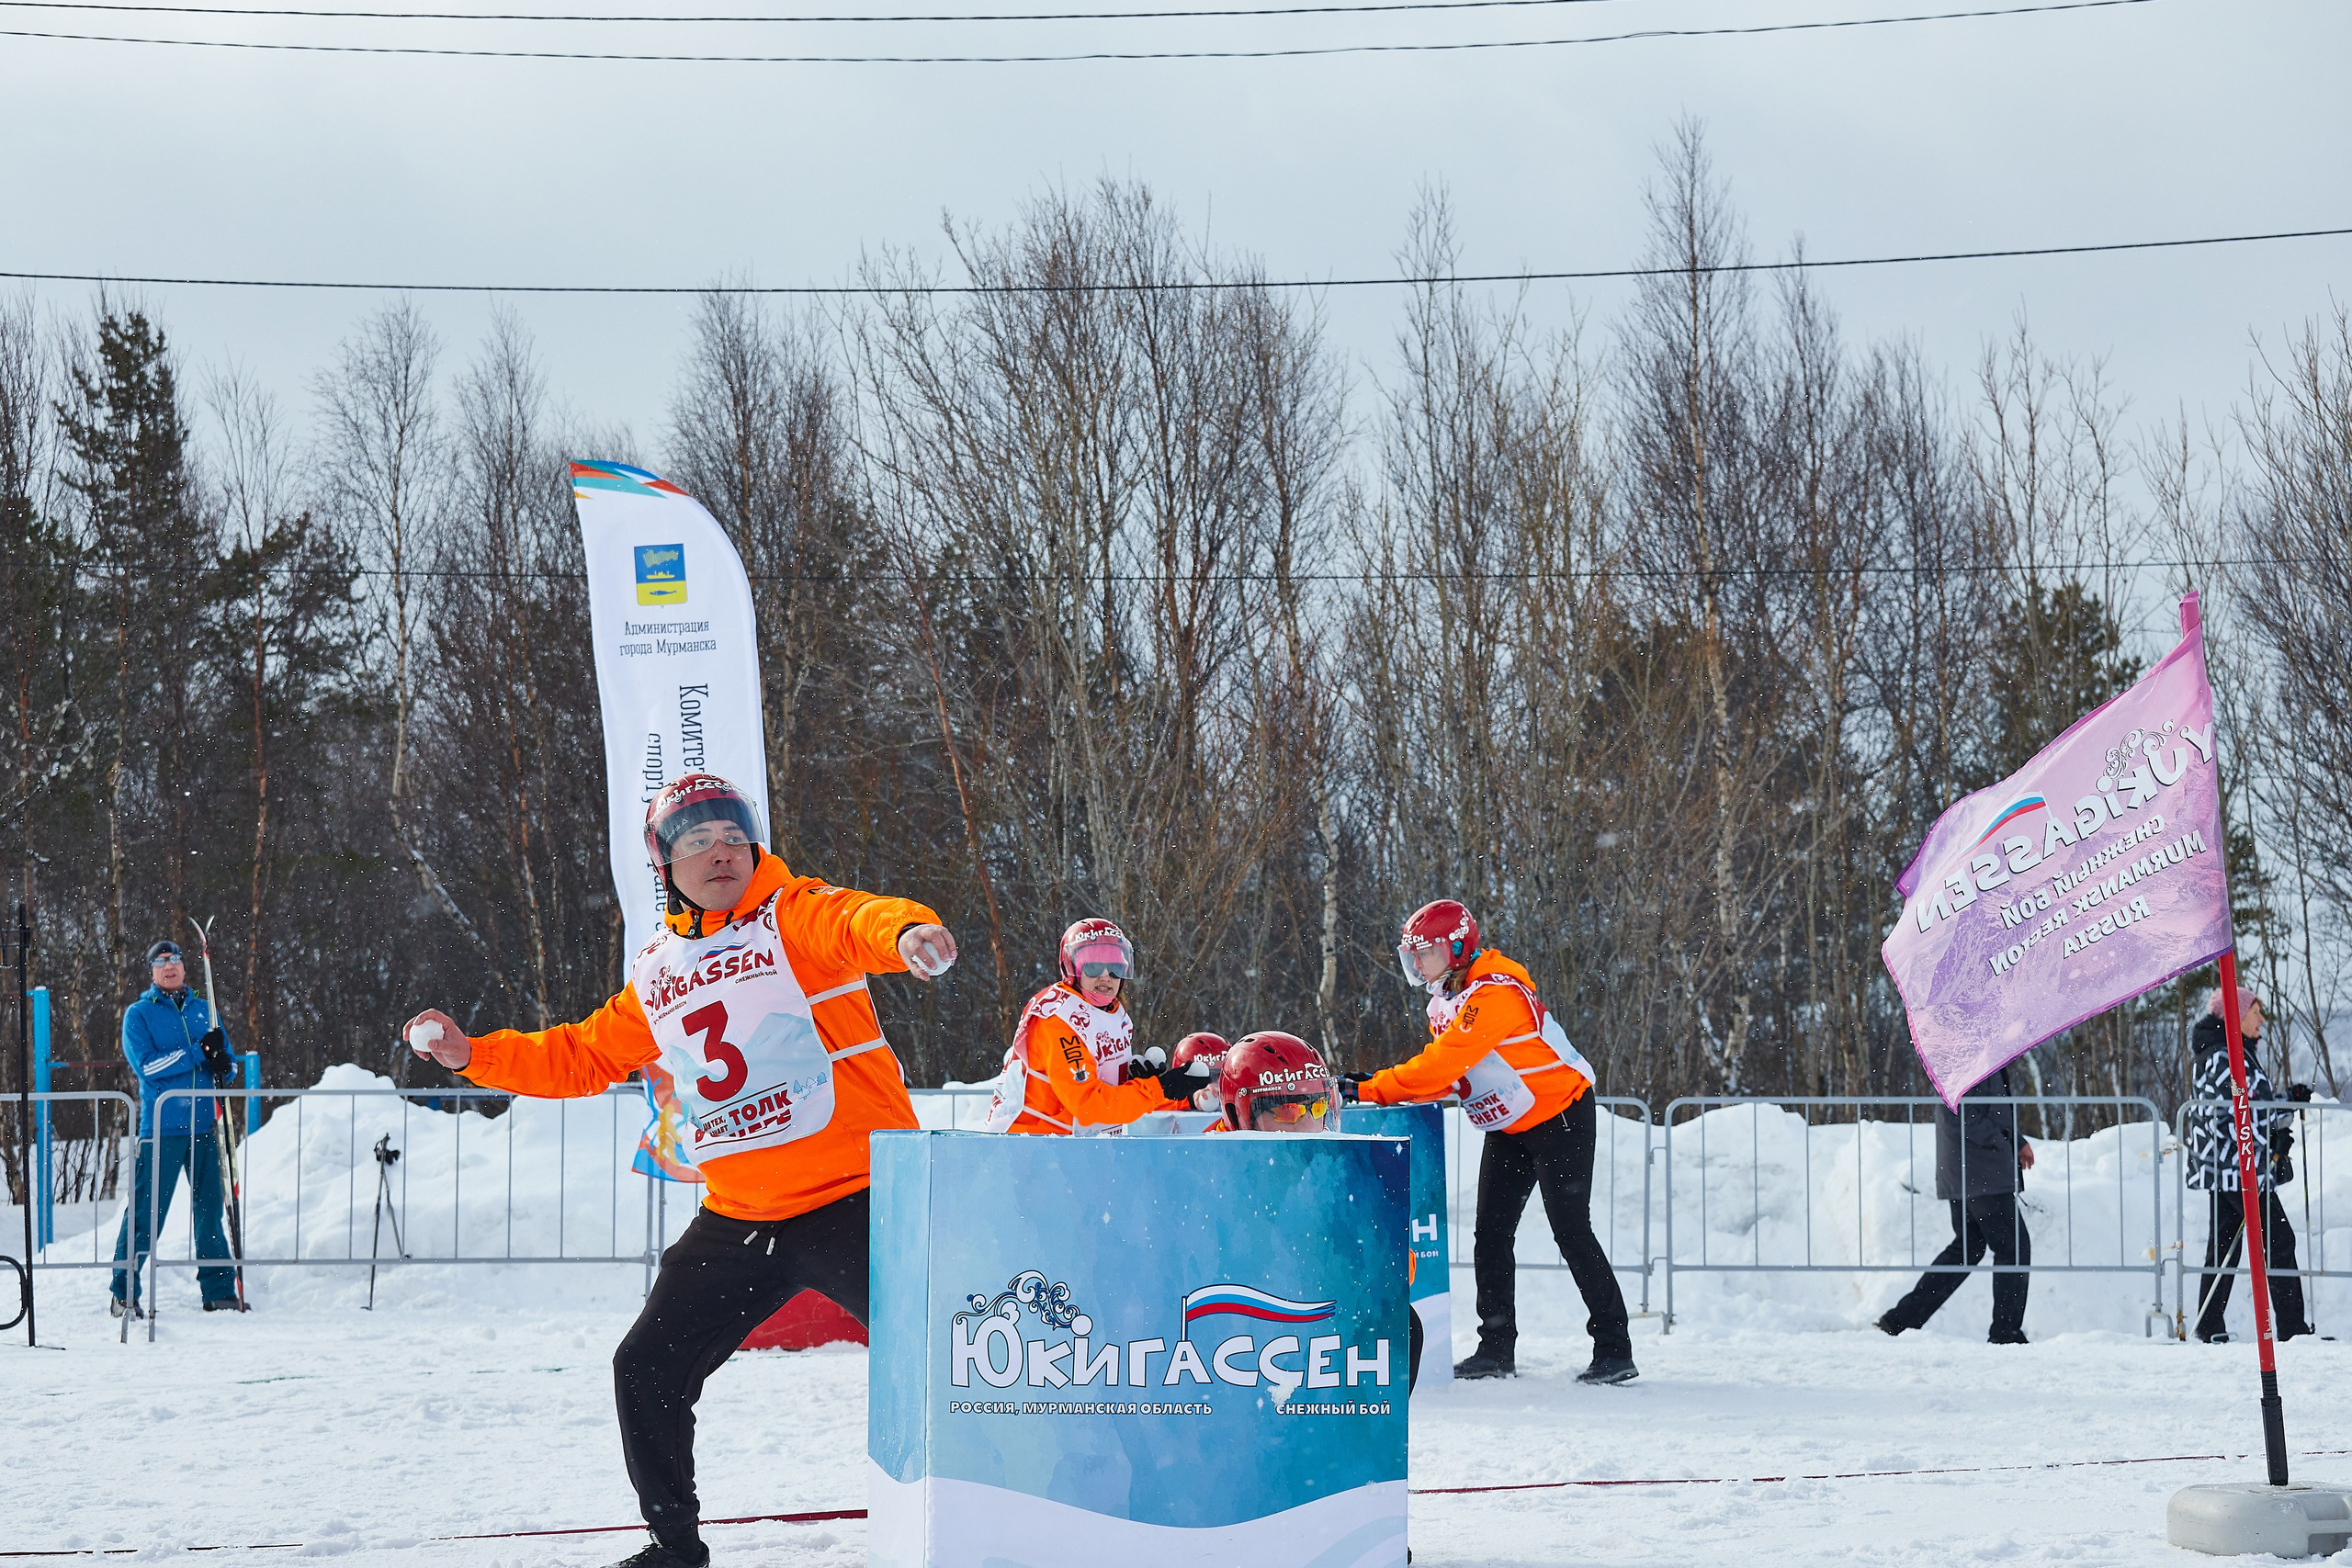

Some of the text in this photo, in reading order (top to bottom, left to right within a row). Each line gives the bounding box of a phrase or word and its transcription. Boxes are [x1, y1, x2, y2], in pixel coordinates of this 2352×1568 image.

[624, 621, 709, 636] Администрация
[619, 639, 717, 658] города Мурманска
[641, 732, 664, 804] спорт
[681, 999, 748, 1102] 3
[728, 1089, 793, 1126] ТОЛК
[1468, 1093, 1500, 1111] ТОЛК
[2238, 1095, 2252, 1171] LISKI
[949, 1401, 1213, 1416] РОССИЯ, МУРМАНСКАЯ ОБЛАСТЬ
[1275, 1400, 1391, 1416] СНЕЖНЫЙ БОЙ
